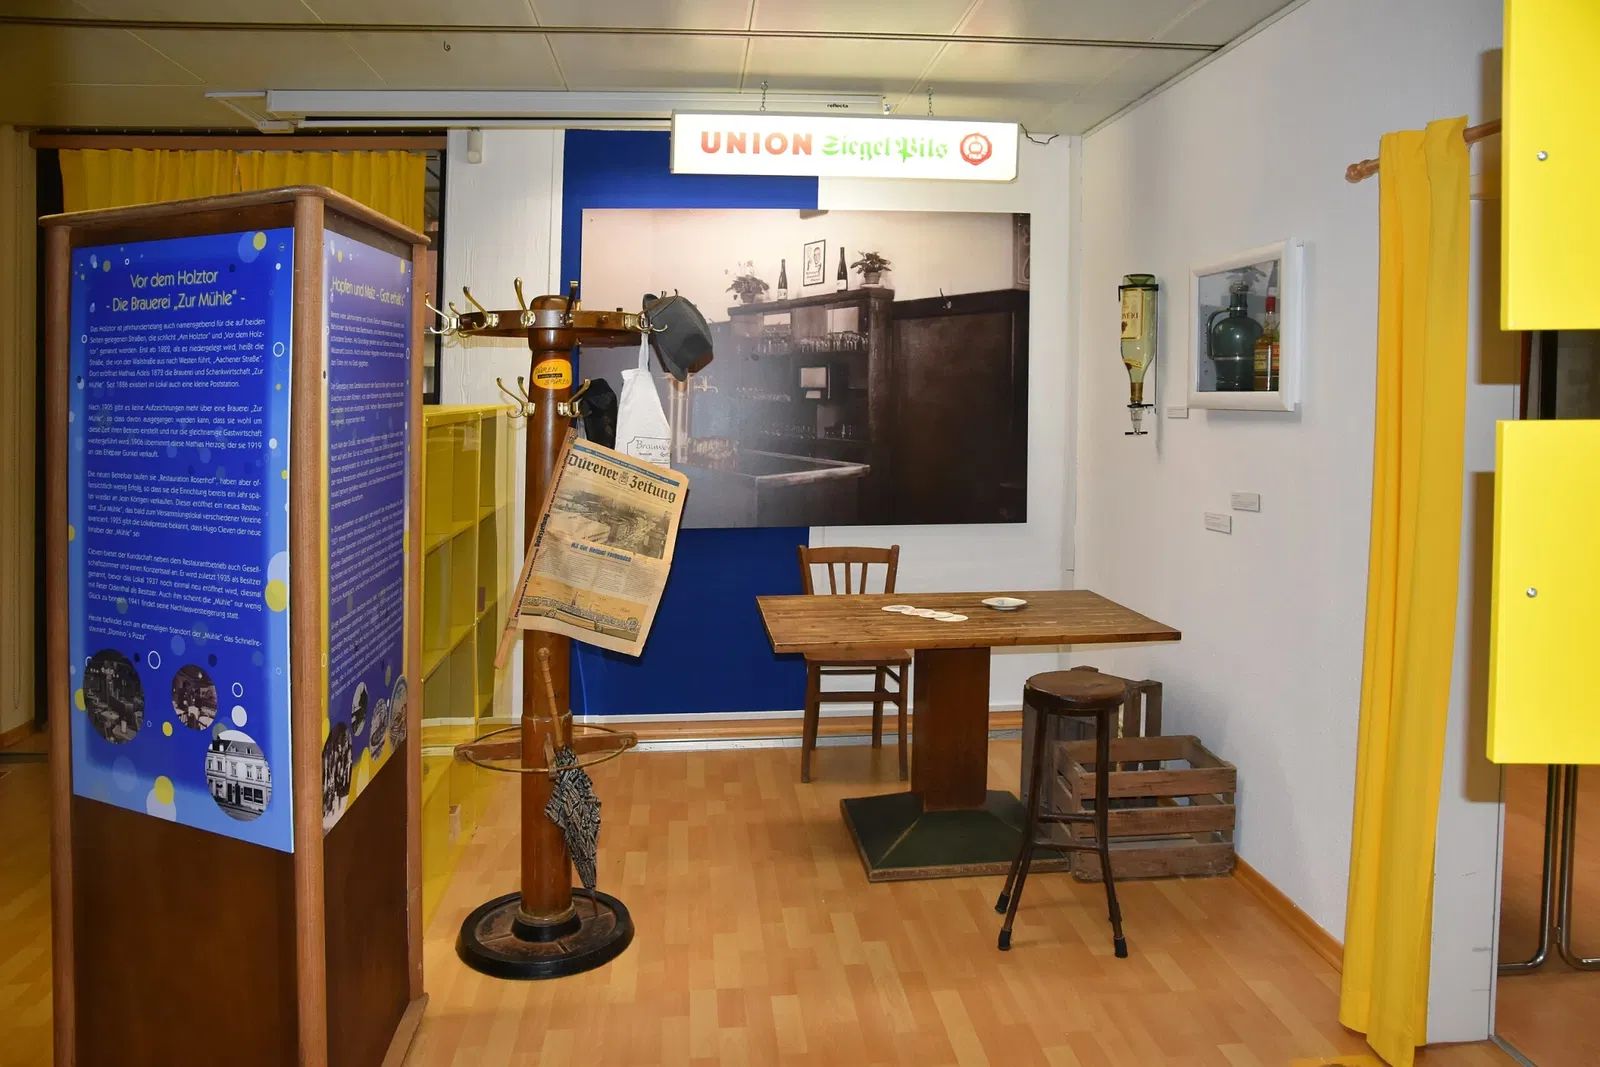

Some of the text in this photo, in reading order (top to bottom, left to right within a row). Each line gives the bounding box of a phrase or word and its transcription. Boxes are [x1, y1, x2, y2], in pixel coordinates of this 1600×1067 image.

[701, 131, 813, 156] UNION
[895, 136, 949, 163] Pils
[130, 267, 217, 288] Vor dem Holztor
[353, 284, 364, 298] und
[365, 284, 375, 300] Malz
[112, 297, 127, 311] Die
[131, 294, 170, 310] Brauerei
[175, 319, 215, 330] namensgebend
[244, 316, 265, 325] beiden
[188, 331, 210, 339] Holztor“
[223, 330, 234, 340] „Vor
[248, 329, 264, 337] Holz-
[188, 342, 221, 353] niedergelegt
[222, 342, 236, 352] wird,
[238, 341, 253, 350] heißt
[197, 355, 211, 364] führt,
[212, 354, 240, 364] „Aachener
[205, 366, 250, 375] Schankwirtschaft
[193, 379, 208, 387] kleine
[185, 403, 198, 411] mehr
[199, 403, 212, 411] über
[213, 403, 225, 411] eine
[226, 403, 248, 411] Brauerei
[197, 415, 210, 425] kann,
[212, 415, 225, 423] dass
[236, 416, 251, 424] wohl
[188, 427, 222, 437] gleichnamige
[222, 427, 262, 436] Gastwirtschaft
[204, 439, 226, 449] Herzog,
[247, 440, 262, 448] 1919
[636, 440, 670, 450] Brauwe
[190, 474, 217, 485] Rosenhof“,
[219, 476, 236, 484] haben
[238, 477, 251, 485] aber
[568, 453, 619, 480] Dürener
[629, 475, 676, 503] Zeitung
[179, 486, 207, 497] Einrichtung
[207, 487, 226, 496] bereits
[236, 489, 247, 497] Jahr
[248, 490, 260, 500] spä-
[241, 501, 260, 510] Restau-
[202, 511, 239, 521] verschiedener
[240, 514, 261, 523] Vereine
[190, 522, 202, 530] dass
[202, 523, 217, 533] Hugo
[217, 524, 236, 533] Cleven
[589, 546, 606, 556] Heimat
[607, 552, 632, 562] verbunden
[182, 557, 226, 569] Restaurantbetrieb
[227, 561, 240, 570] auch
[241, 563, 260, 572] Gesell-
[185, 569, 197, 577] wird
[198, 570, 216, 580] zuletzt
[216, 572, 230, 581] 1935
[239, 574, 261, 585] Besitzer
[224, 585, 238, 596] wird,
[240, 587, 261, 597] diesmal
[183, 592, 201, 602] scheint
[244, 599, 261, 611] wenig
[170, 602, 225, 618] Nachlassversteigerung
[234, 634, 261, 646] Schnellre-
